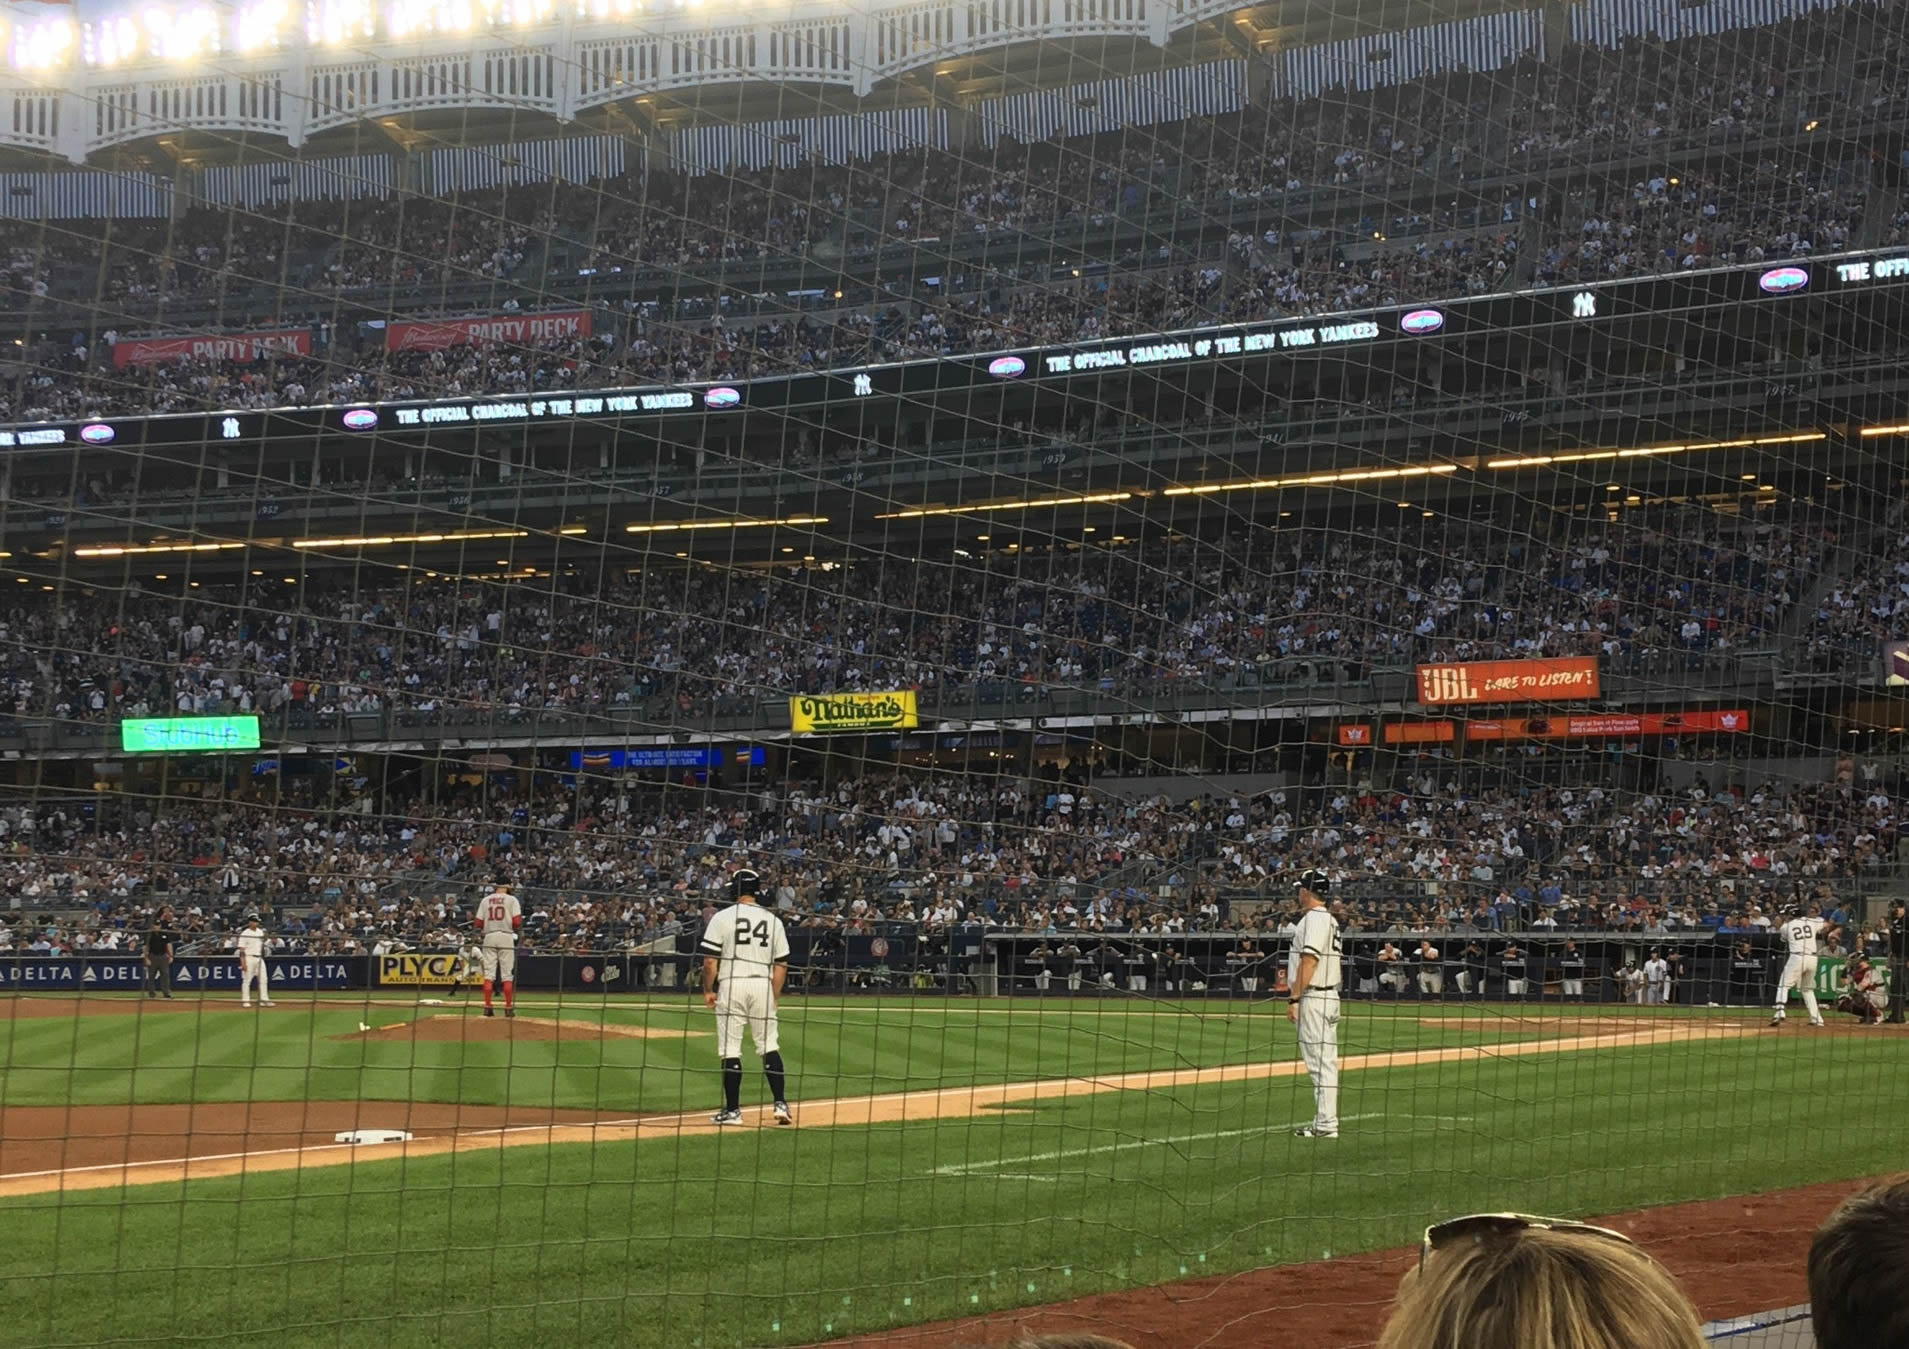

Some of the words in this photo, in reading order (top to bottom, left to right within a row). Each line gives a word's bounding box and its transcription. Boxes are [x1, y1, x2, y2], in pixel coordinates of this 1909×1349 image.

[1836, 262, 1870, 281] THE
[468, 321, 525, 342] PARTY
[530, 317, 579, 338] DECK
[193, 338, 248, 360] PARTY
[1046, 355, 1071, 372] THE
[1074, 350, 1126, 370] OFFICIAL
[1129, 342, 1192, 363] CHARCOAL
[1195, 340, 1211, 356] OF
[1215, 336, 1240, 353] THE
[1244, 333, 1275, 350] NEW
[1280, 328, 1315, 347] YORK
[1319, 321, 1379, 343] YANKEES
[396, 409, 420, 424] THE
[422, 406, 470, 423] OFFICIAL
[472, 403, 528, 420] CHARCOAL
[531, 401, 546, 416] OF
[549, 399, 573, 415] THE
[575, 398, 603, 414] NEW
[607, 395, 638, 411] YORK
[640, 392, 693, 409] YANKEES
[1427, 667, 1478, 701] JBL
[800, 695, 902, 721] Nathan's
[488, 905, 505, 921] 10
[735, 917, 769, 948] 24
[10, 966, 72, 980] DELTA
[290, 964, 347, 979] DELTA
